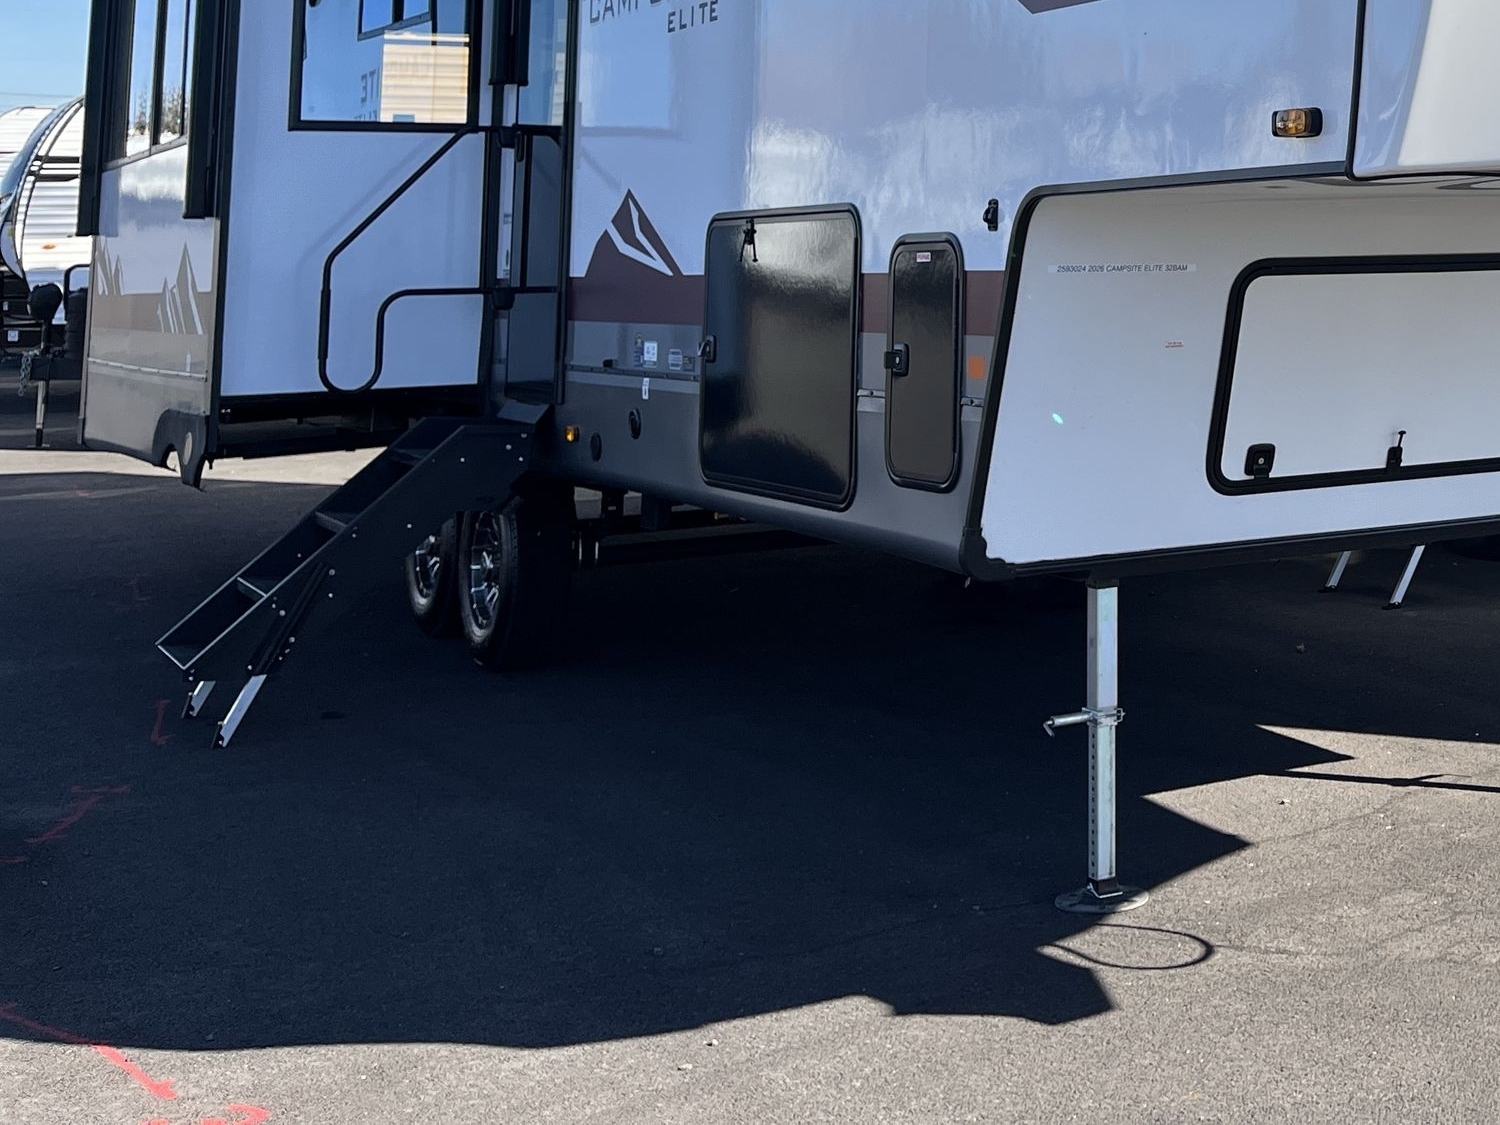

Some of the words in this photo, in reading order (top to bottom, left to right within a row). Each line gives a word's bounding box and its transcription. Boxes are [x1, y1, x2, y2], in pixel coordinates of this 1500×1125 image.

[667, 0, 719, 33] ELITE
[1105, 263, 1143, 273] CAMPSITE
[1144, 264, 1164, 272] ELITE
